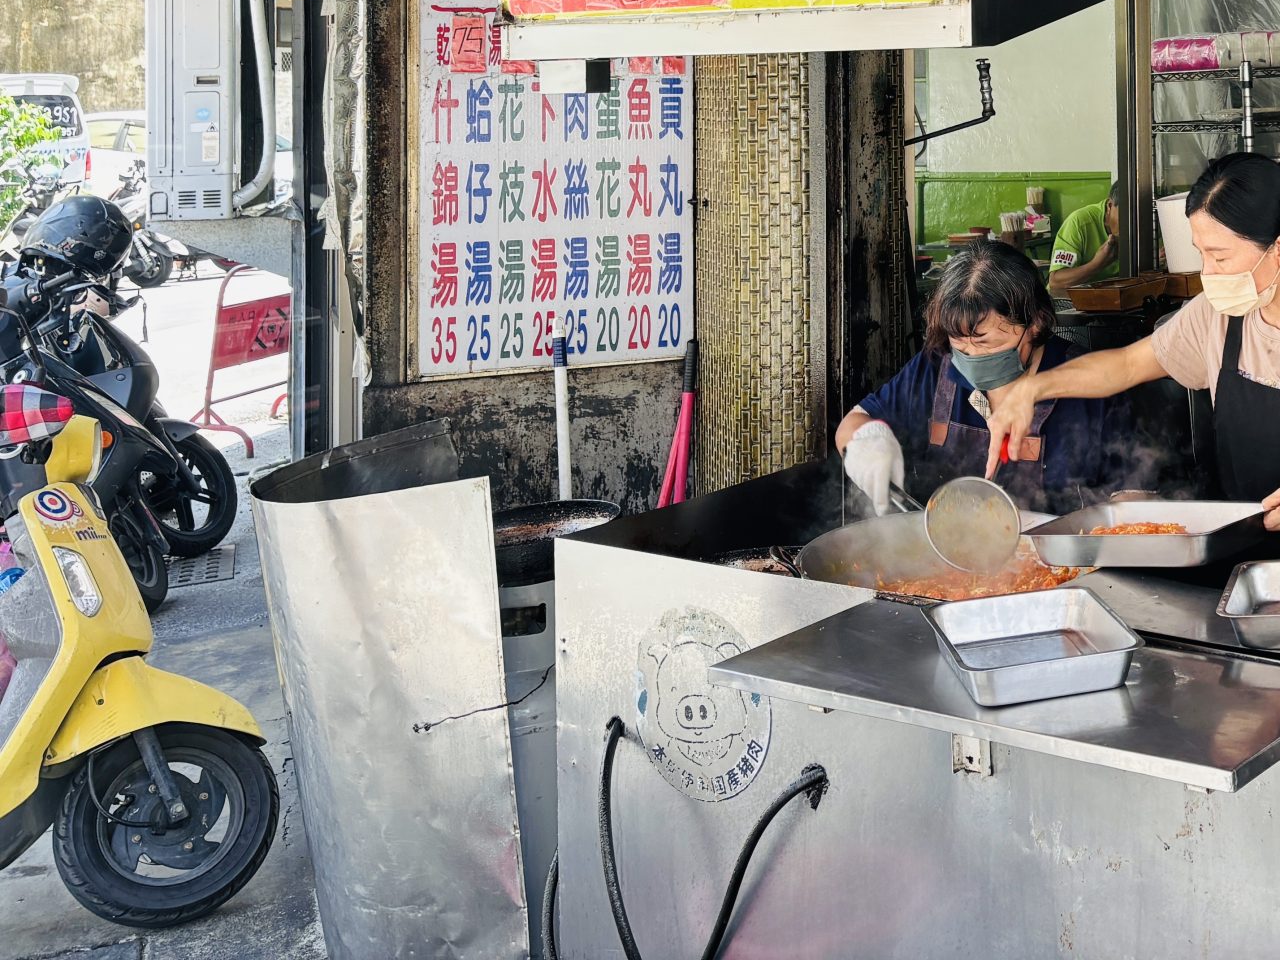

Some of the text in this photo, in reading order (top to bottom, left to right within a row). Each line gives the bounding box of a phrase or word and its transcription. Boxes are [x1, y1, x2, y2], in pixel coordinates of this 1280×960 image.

[453, 27, 482, 54] 75
[430, 78, 459, 308] 什錦湯
[465, 78, 493, 307] 蛤仔湯
[498, 78, 525, 305] 花枝湯
[627, 77, 652, 297] 魚丸湯
[657, 77, 683, 295] 貢丸湯
[431, 316, 457, 364] 35
[467, 314, 491, 361] 25
[500, 312, 523, 359] 25
[596, 306, 620, 352] 20
[628, 304, 650, 350] 20
[658, 302, 681, 349] 20
[75, 526, 98, 540] mii
